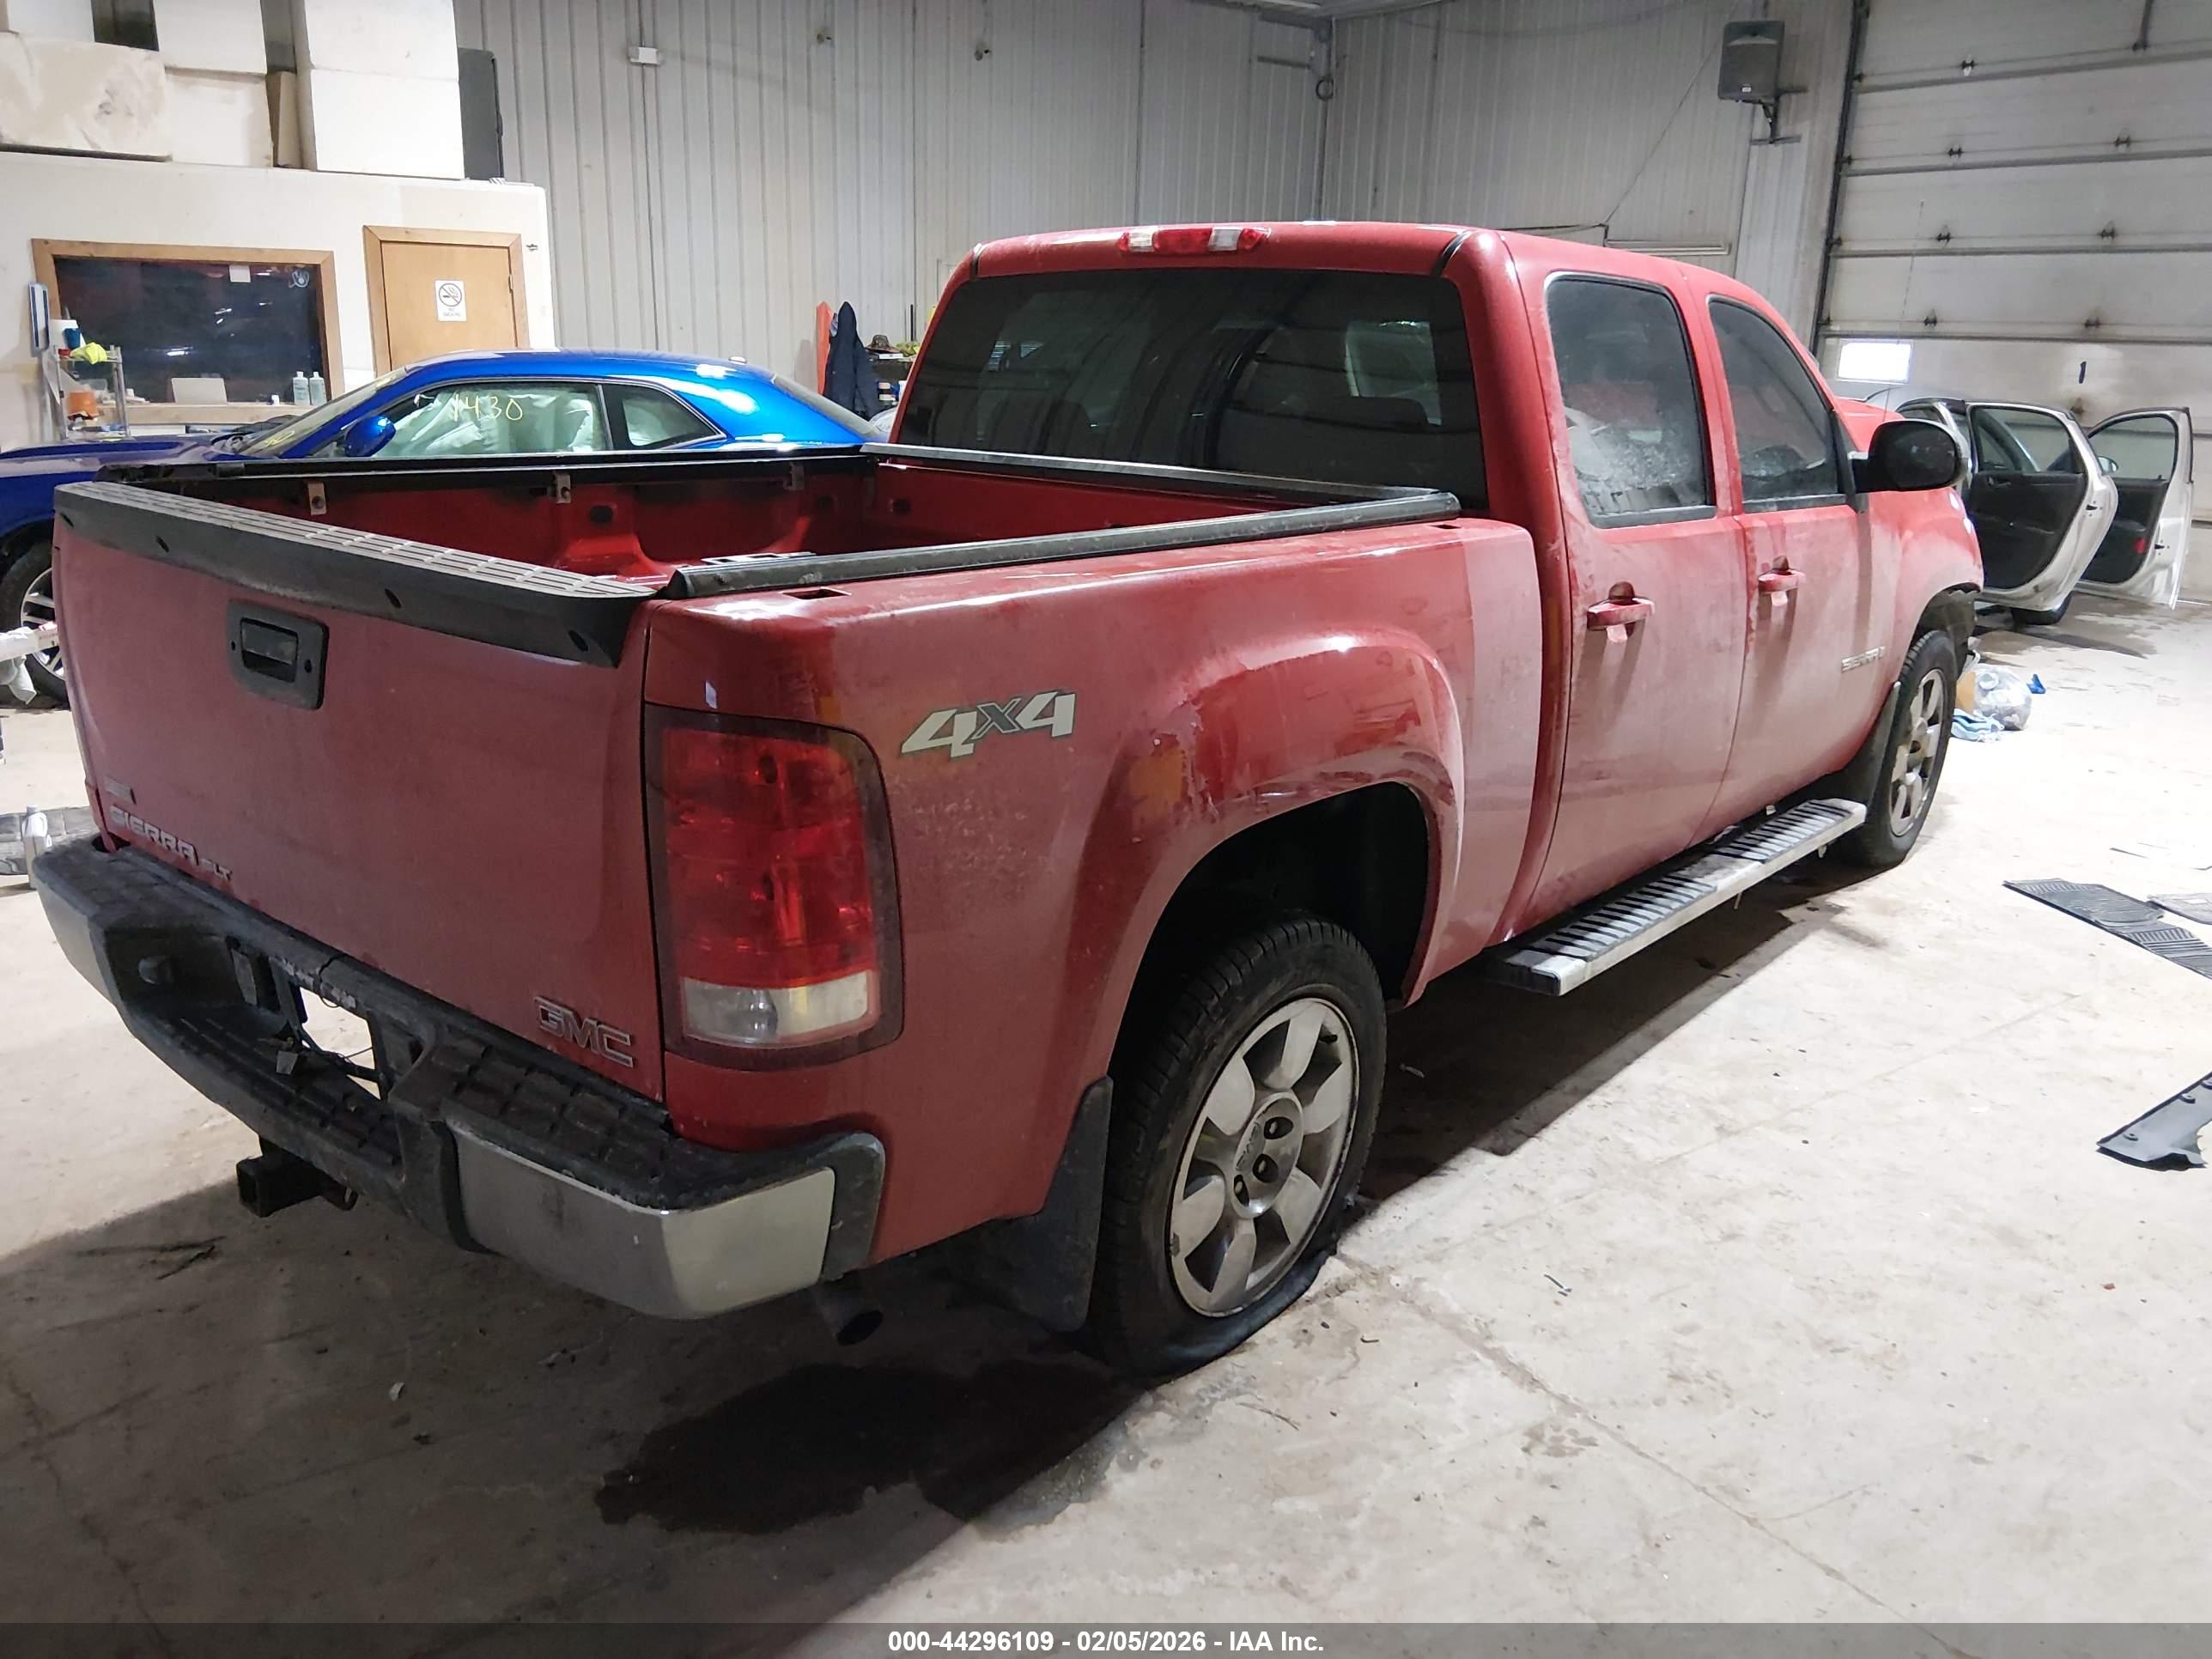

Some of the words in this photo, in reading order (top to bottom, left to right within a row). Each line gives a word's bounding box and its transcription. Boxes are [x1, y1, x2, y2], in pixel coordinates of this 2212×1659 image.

[453, 393, 523, 422] 1430
[109, 805, 199, 866] SIERRA
[534, 995, 634, 1068] GMC
